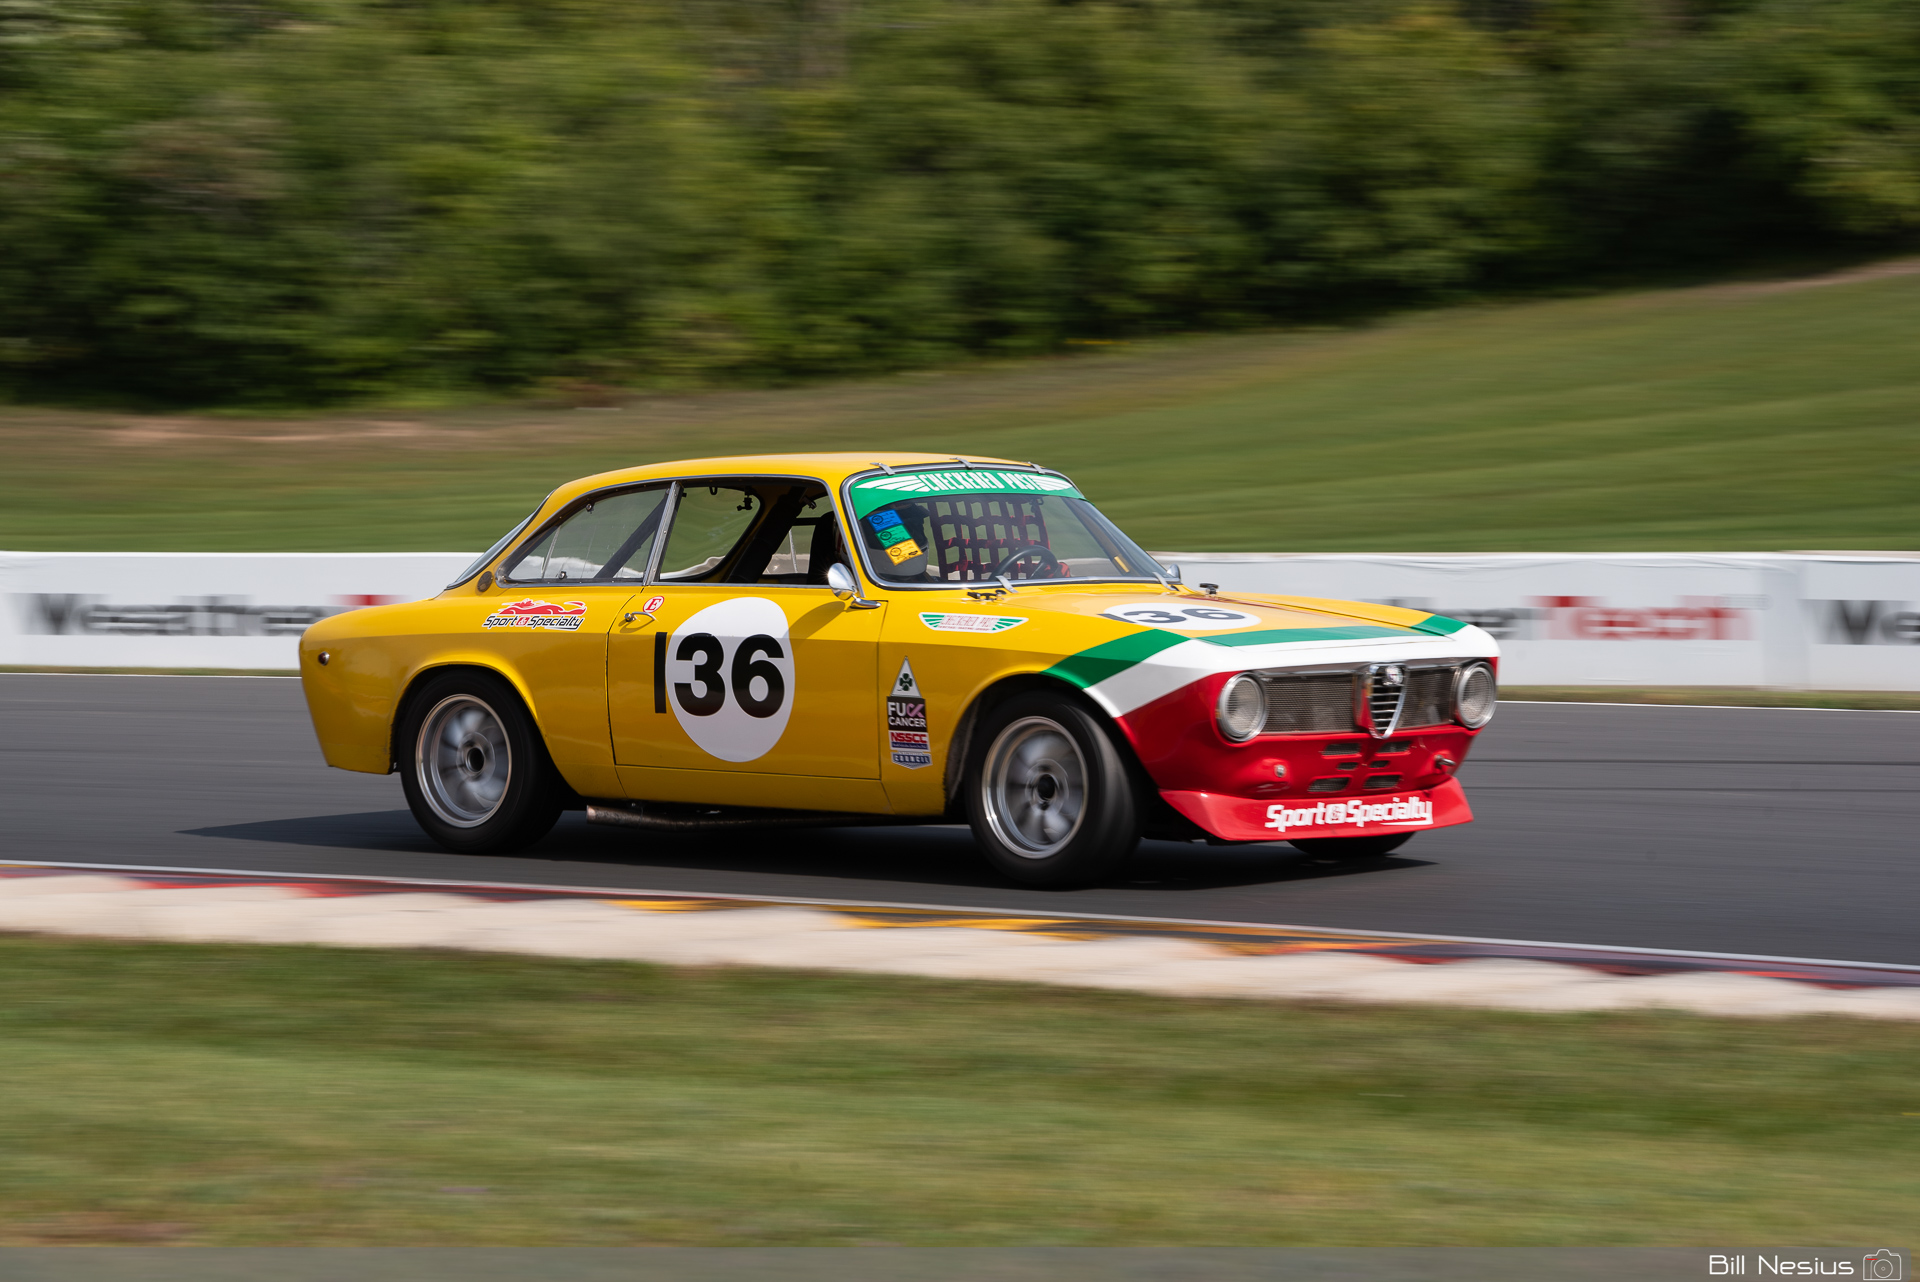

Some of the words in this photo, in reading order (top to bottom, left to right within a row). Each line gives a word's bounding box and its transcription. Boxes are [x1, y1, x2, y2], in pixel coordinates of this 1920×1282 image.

[918, 471, 1005, 492] CHECKERED
[645, 598, 662, 611] E
[483, 615, 518, 629] Sport
[528, 615, 584, 630] Specialty
[1097, 607, 1246, 624] 136
[654, 632, 785, 719] 136
[888, 716, 927, 728] CANCER
[1265, 801, 1326, 832] Sport
[1346, 796, 1434, 827] Specialty
